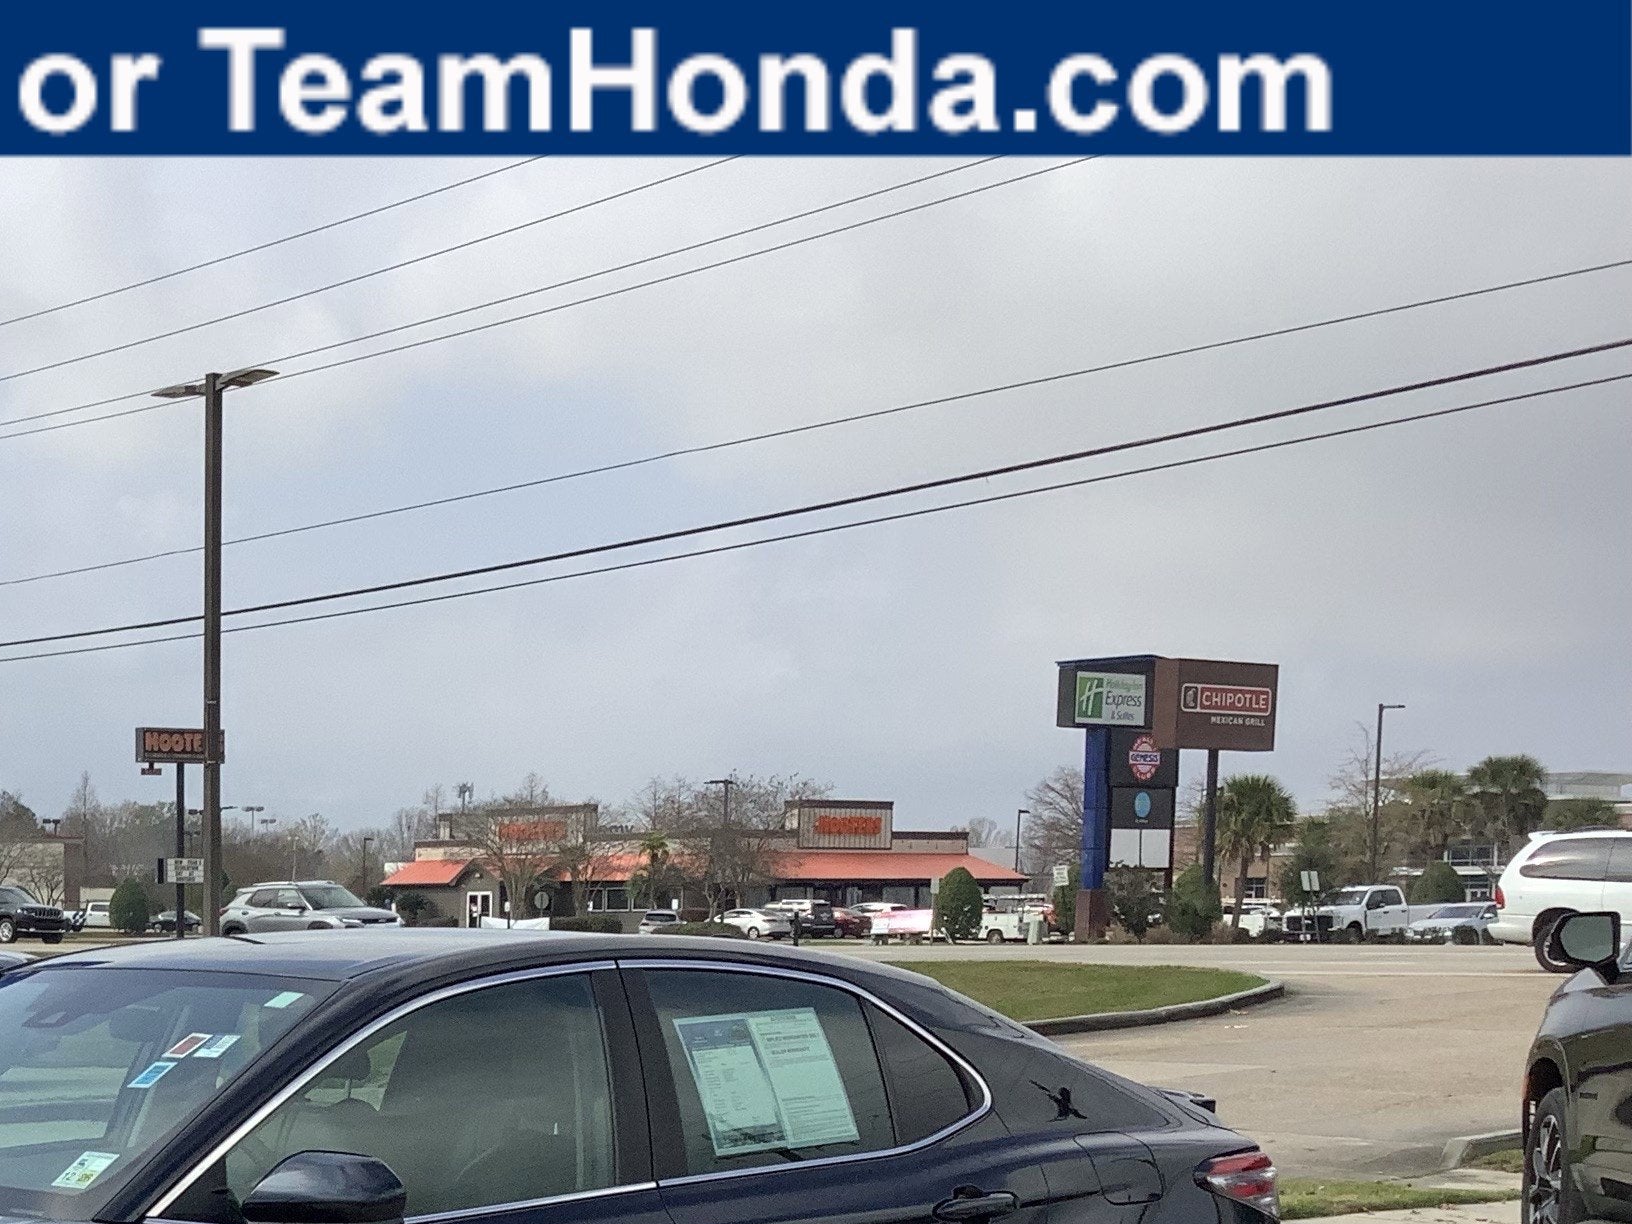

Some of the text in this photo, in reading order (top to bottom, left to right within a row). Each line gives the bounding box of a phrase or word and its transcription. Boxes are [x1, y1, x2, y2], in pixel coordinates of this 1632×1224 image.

[1104, 690, 1143, 709] Express
[1201, 691, 1268, 709] CHIPOTLE
[1210, 715, 1266, 727] MEXICAN GRILL
